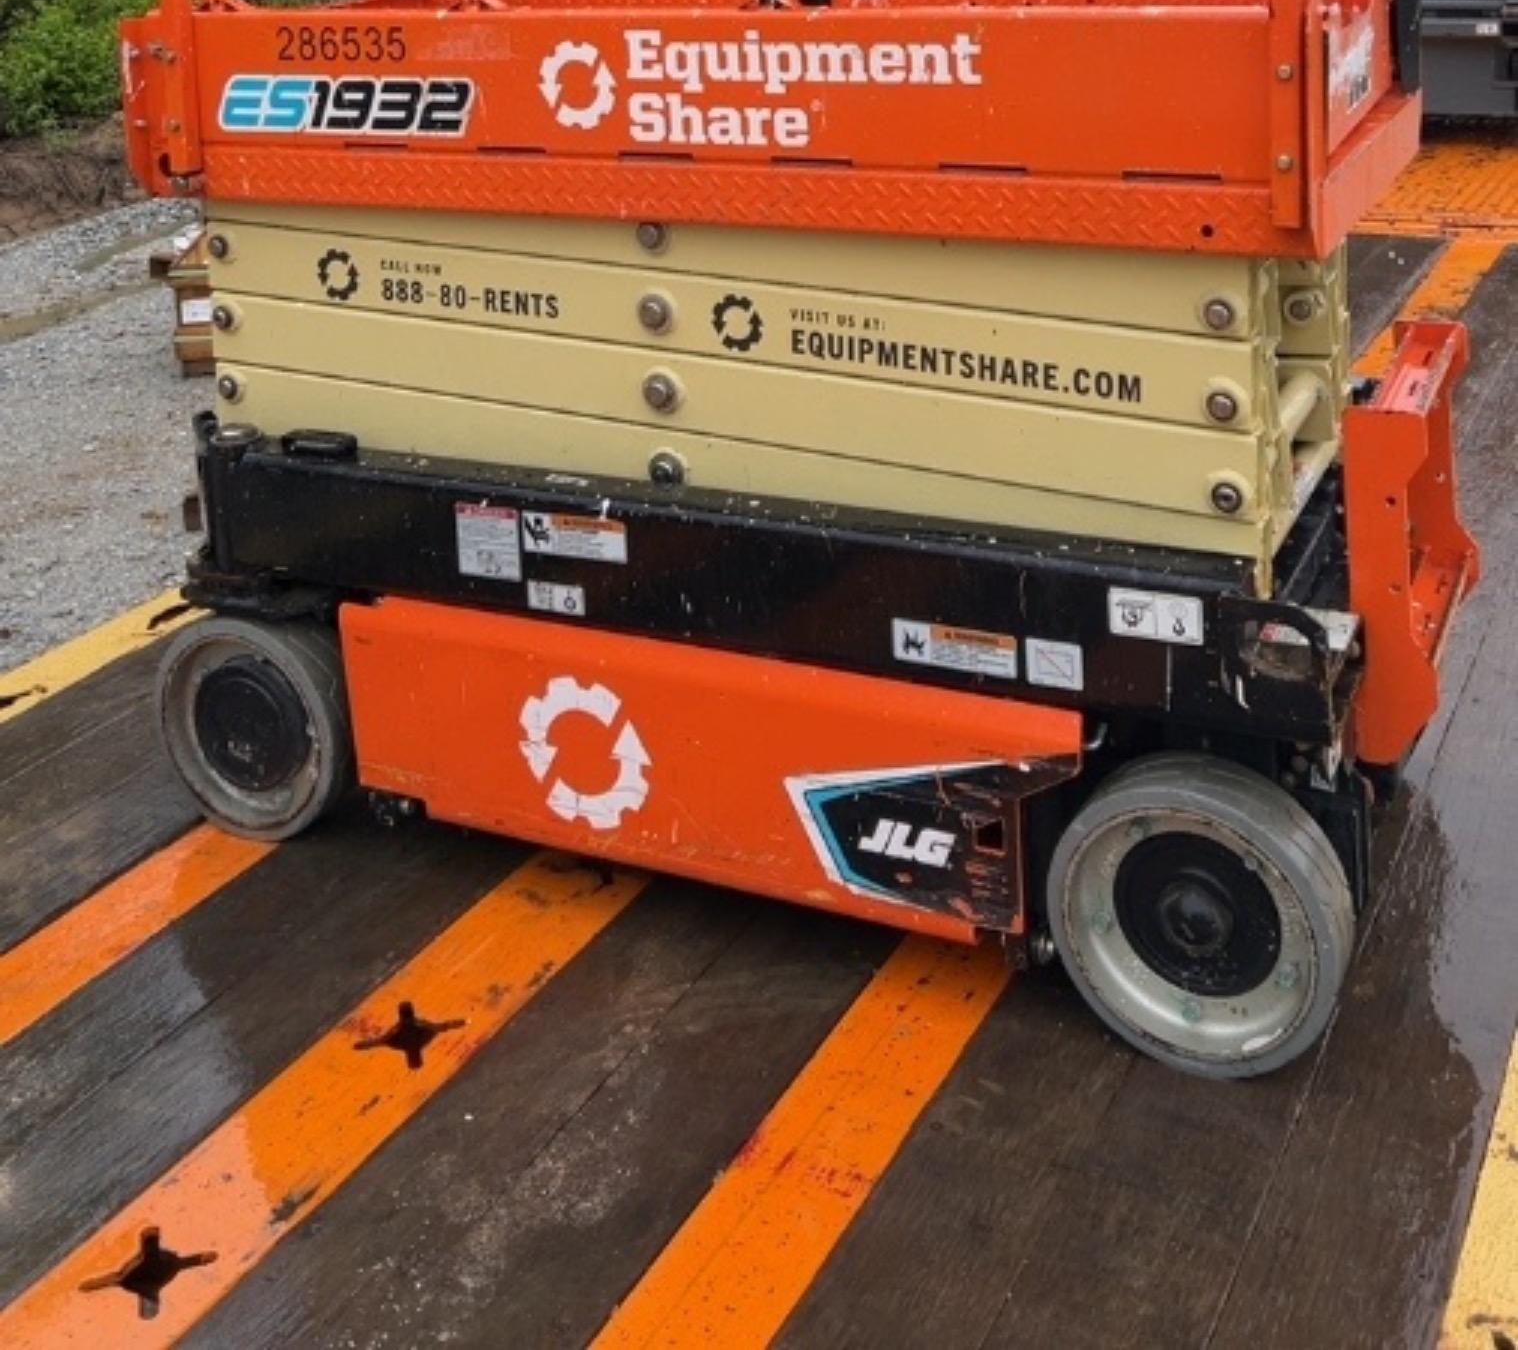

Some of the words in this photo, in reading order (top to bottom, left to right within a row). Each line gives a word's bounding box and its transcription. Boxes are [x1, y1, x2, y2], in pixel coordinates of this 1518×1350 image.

[275, 26, 407, 61] 286535
[624, 29, 982, 94] Equipment
[220, 76, 472, 134] ES1932
[628, 93, 810, 147] Share
[380, 258, 409, 274] CALL
[381, 277, 559, 319] 888-80-RENTS
[789, 308, 829, 324] VISIT
[836, 313, 855, 329] US
[863, 317, 887, 332] AT:
[790, 328, 1143, 404] EQUIPMENTSHARE.COM
[857, 818, 957, 868] JLG
